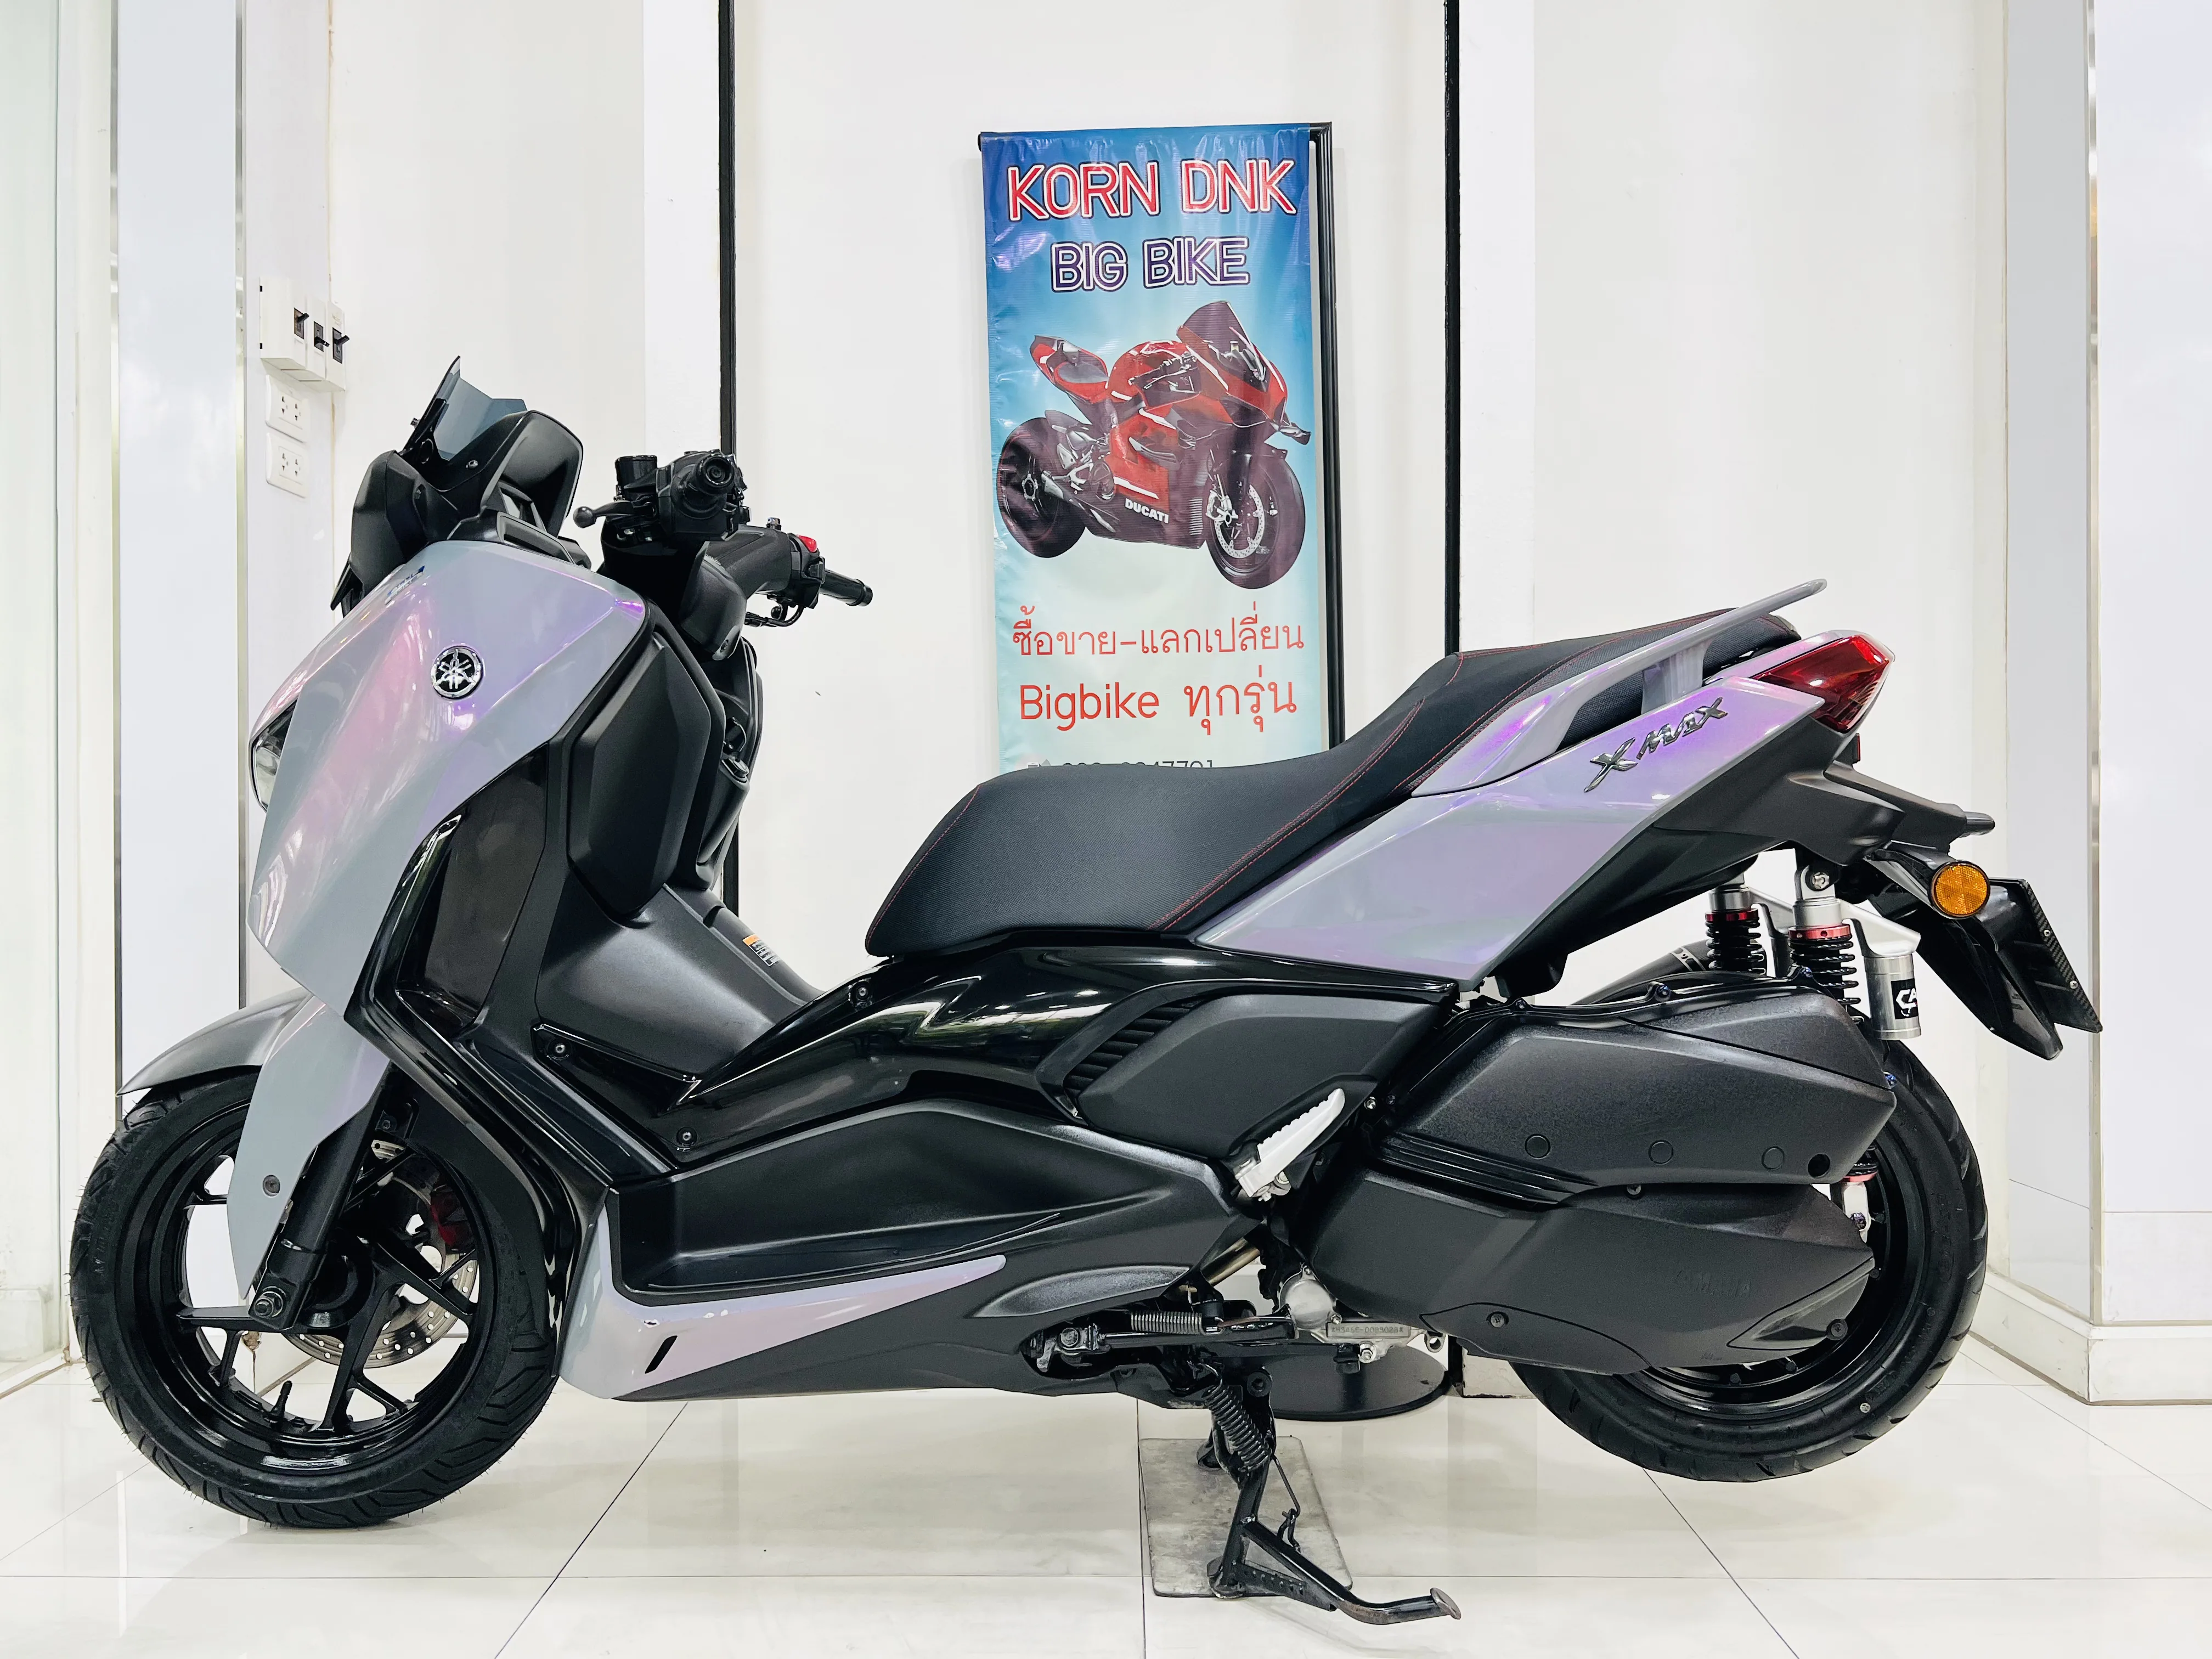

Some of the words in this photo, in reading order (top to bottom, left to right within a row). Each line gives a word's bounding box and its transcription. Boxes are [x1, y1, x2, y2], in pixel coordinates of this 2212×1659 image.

[1007, 161, 1160, 222] KORN
[1181, 159, 1297, 215] DNK
[1051, 241, 1128, 292] BIG
[1143, 236, 1250, 288] BIKE
[1124, 498, 1169, 524] DUCATI
[1012, 601, 1305, 656] ซื้อขาย-แลกเปลี่ยน
[1019, 682, 1160, 731] Bigbike
[1183, 665, 1297, 736] ทุกรุ่น
